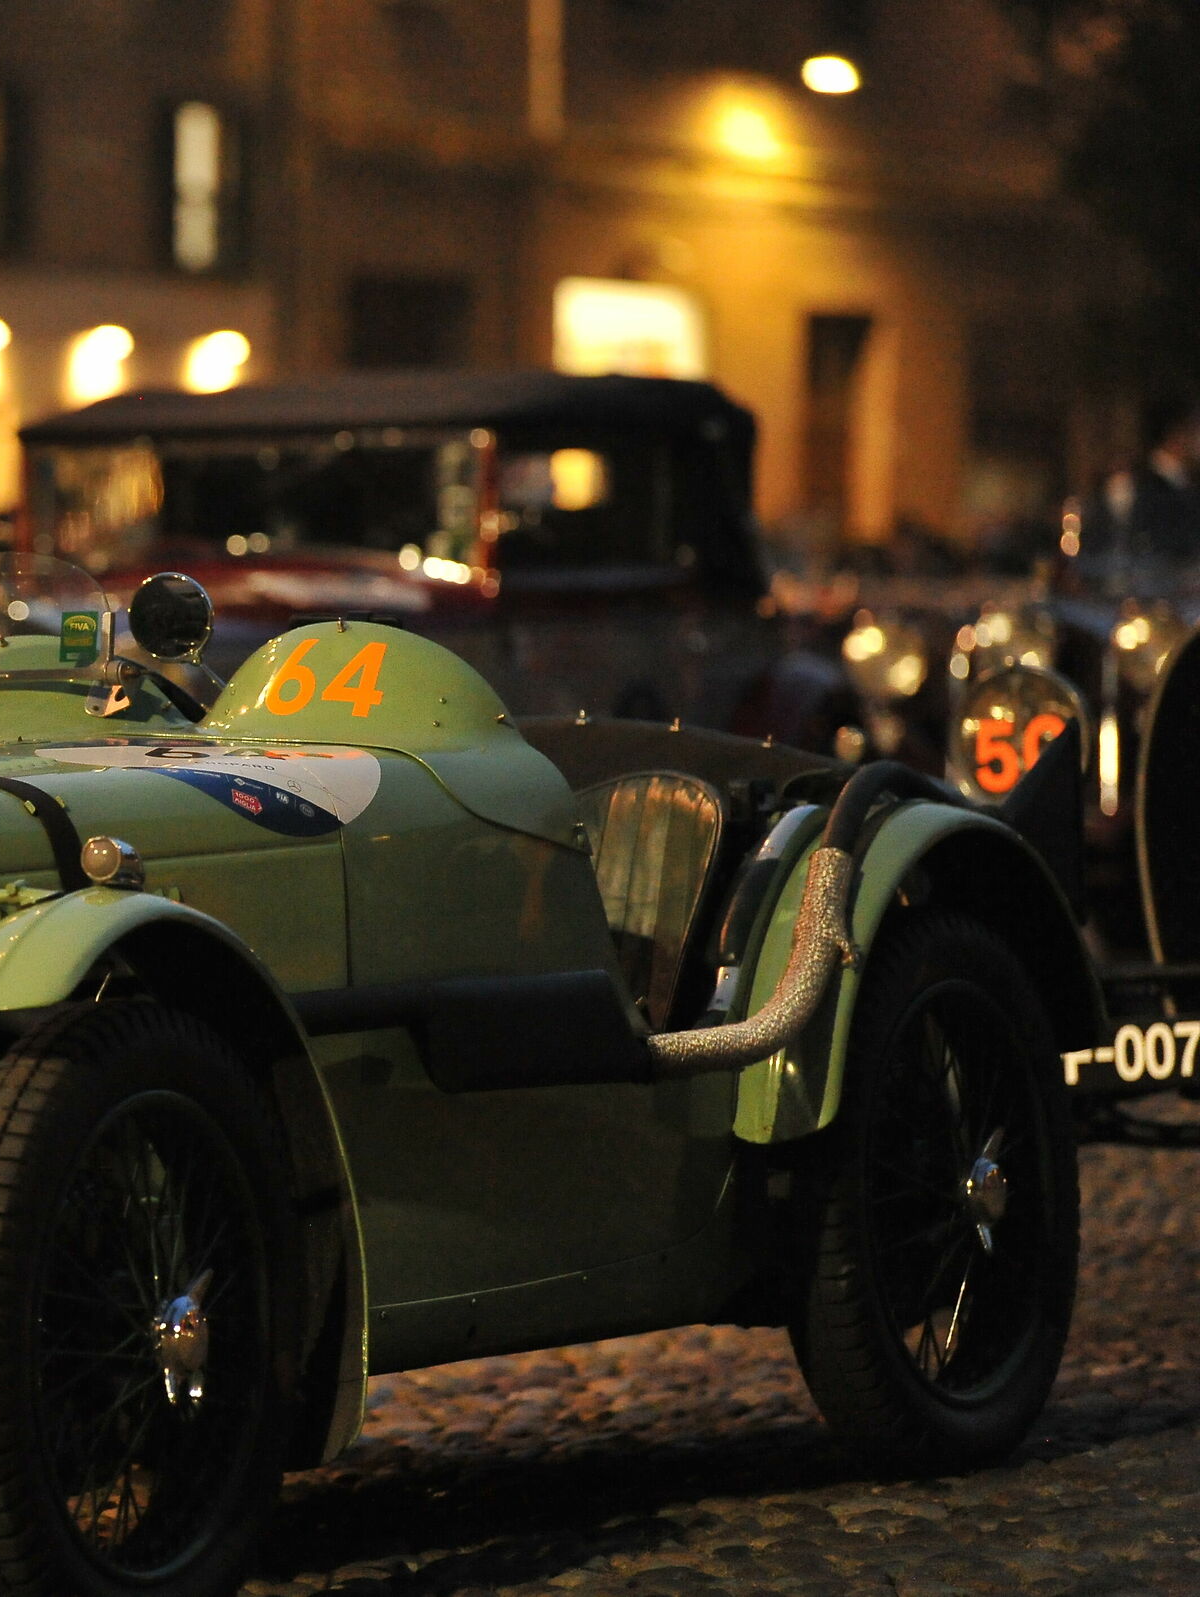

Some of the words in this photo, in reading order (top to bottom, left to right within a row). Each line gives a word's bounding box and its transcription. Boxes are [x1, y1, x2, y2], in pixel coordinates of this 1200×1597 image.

[70, 622, 89, 631] FIVA
[265, 638, 388, 718] 64
[235, 791, 256, 804] 1000
